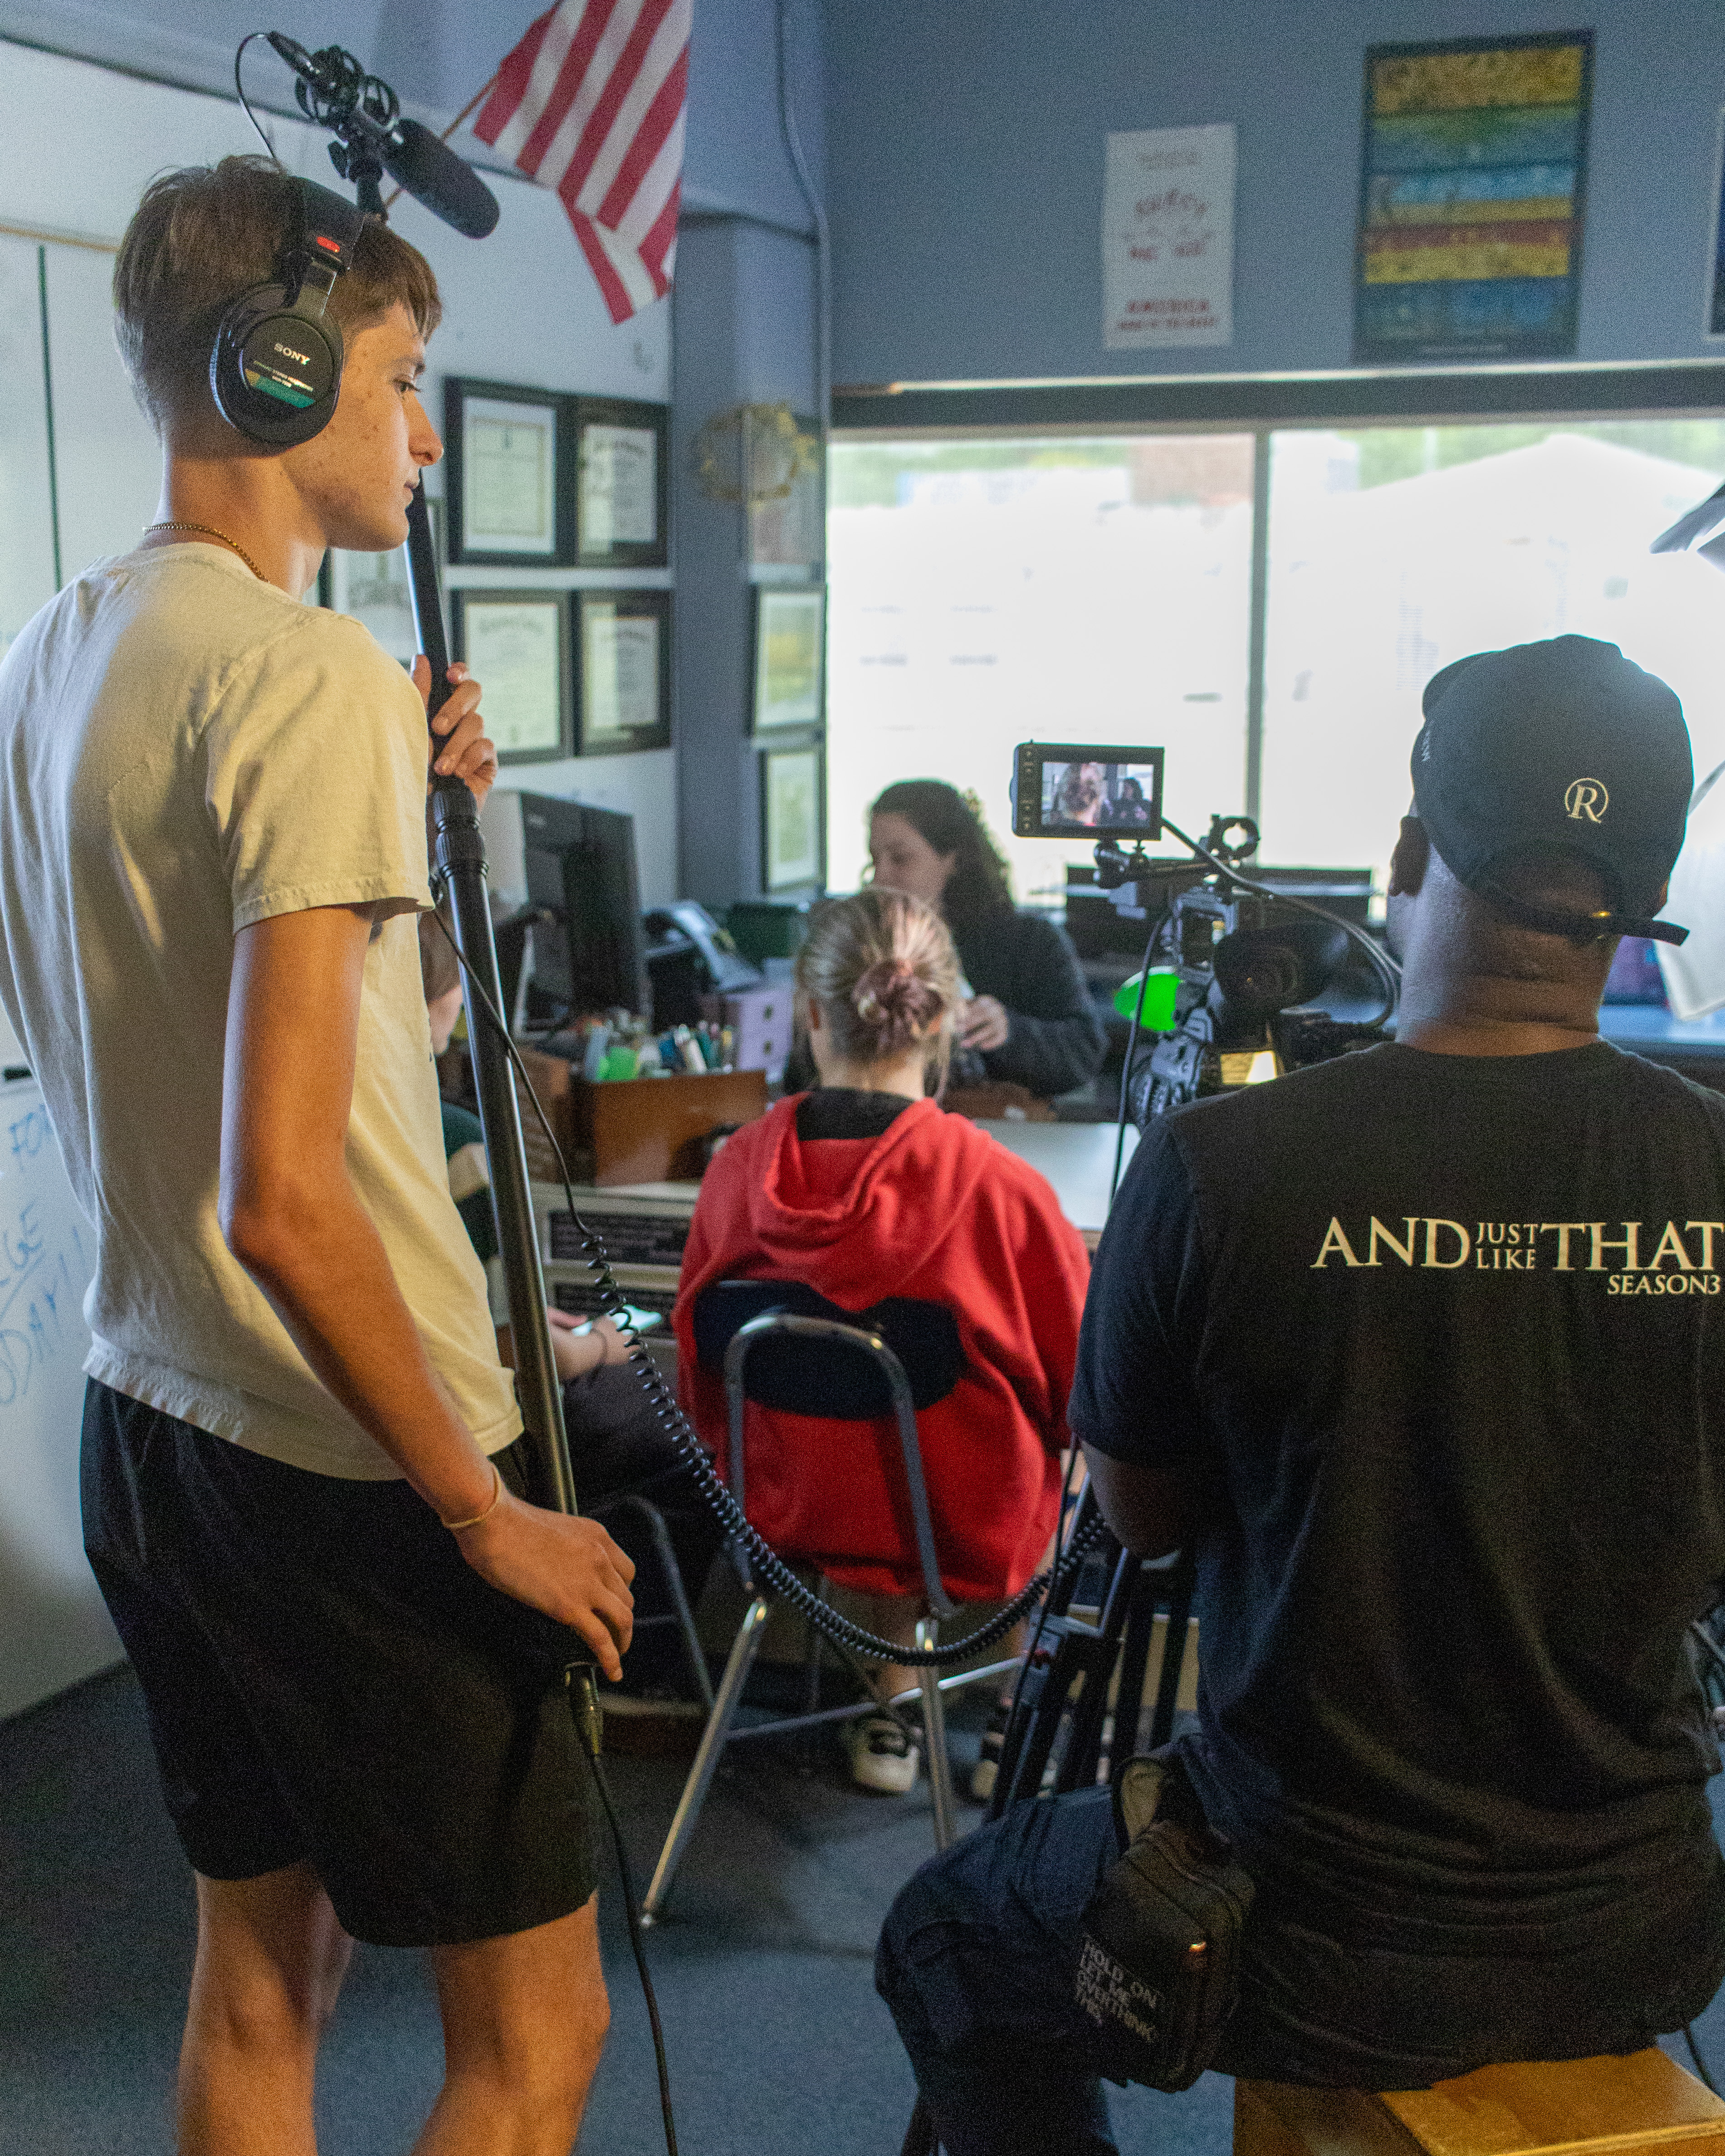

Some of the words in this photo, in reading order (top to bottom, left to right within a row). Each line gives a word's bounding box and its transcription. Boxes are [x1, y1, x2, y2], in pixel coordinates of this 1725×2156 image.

[274, 342, 311, 366] SONY
[1311, 1216, 1470, 1268] AND
[1476, 1222, 1537, 1244] JUST
[1540, 1220, 1724, 1271] THAT
[1476, 1248, 1535, 1270] LIKE
[1079, 1953, 1104, 1982] LET
[1109, 1980, 1132, 2009] ME
[1083, 1941, 1124, 1984] HOLD
[1130, 1981, 1158, 2010] ON
